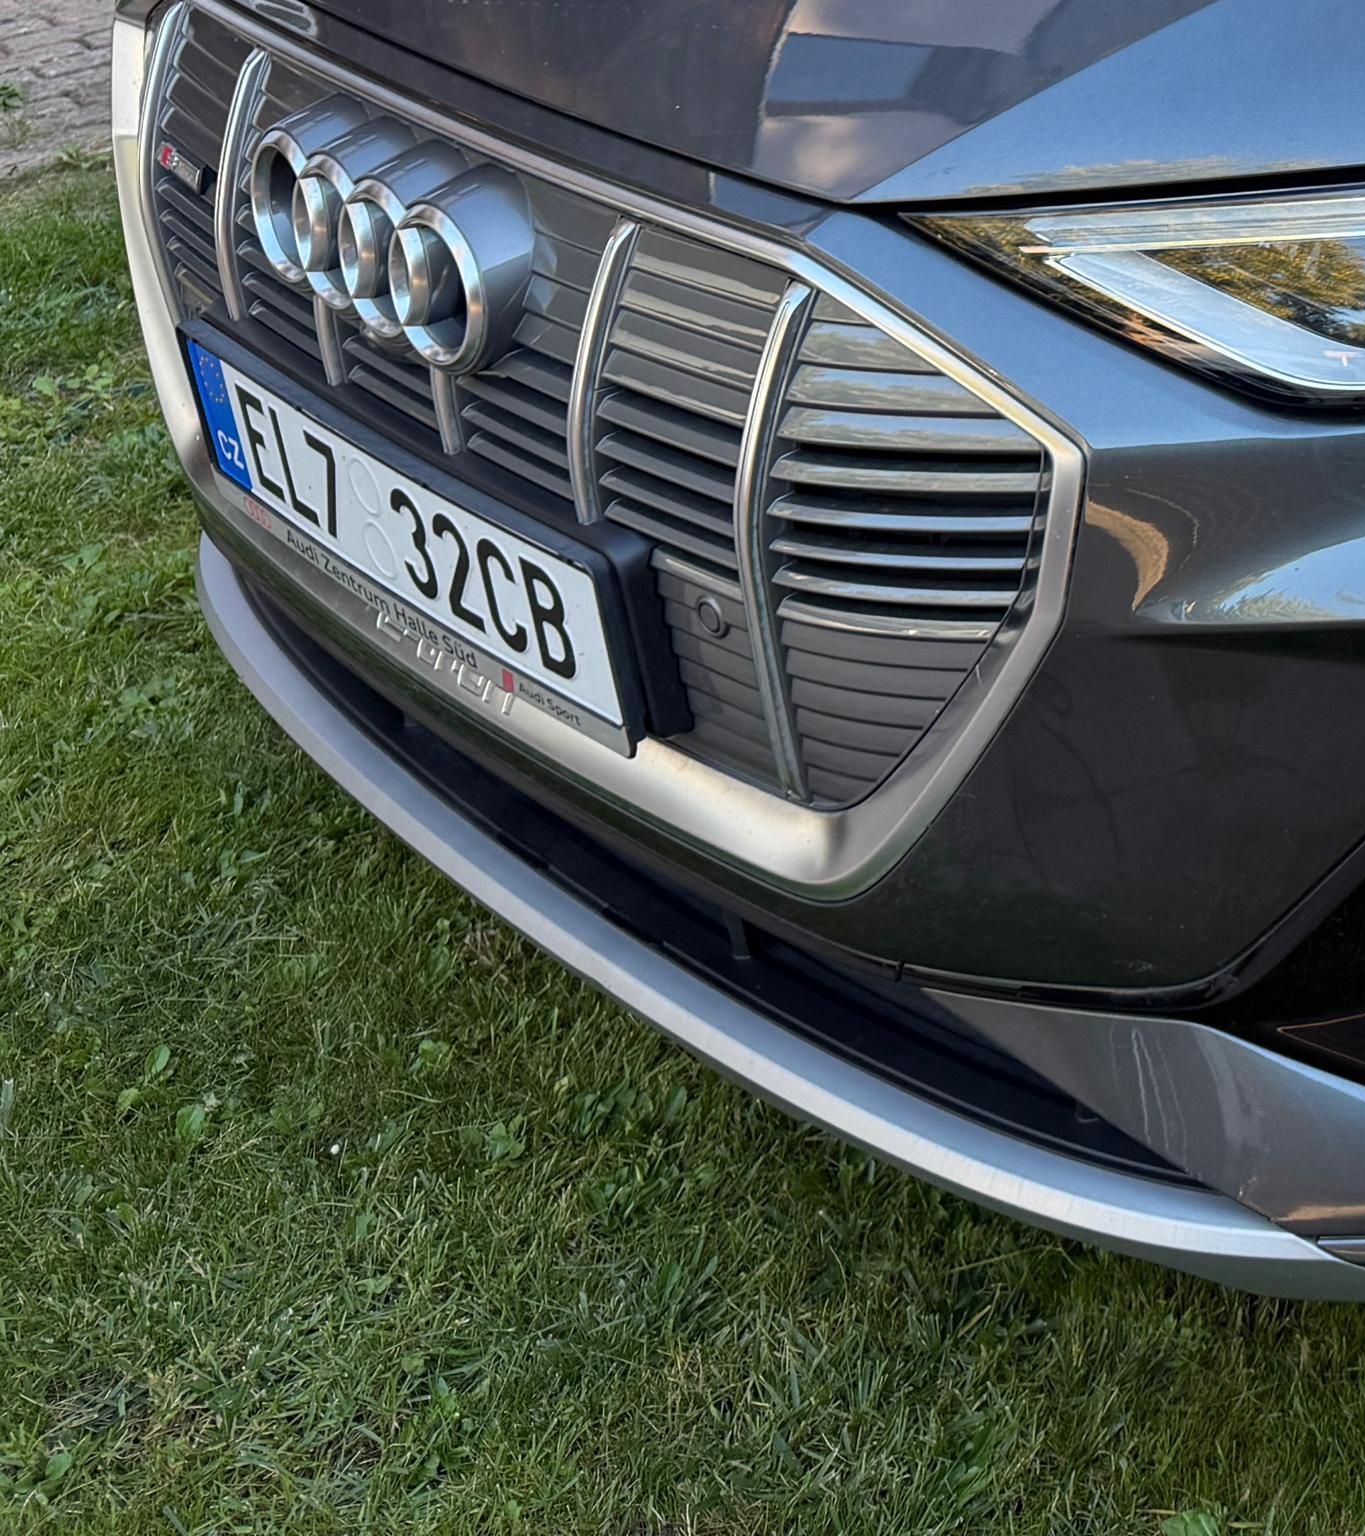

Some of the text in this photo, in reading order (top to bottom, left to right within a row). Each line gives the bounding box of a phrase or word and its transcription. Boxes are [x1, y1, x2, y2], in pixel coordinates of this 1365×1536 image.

[217, 430, 244, 470] CZ
[234, 383, 577, 680] EL7 32CB
[287, 529, 478, 670] Audi Zentrum Halle Süd
